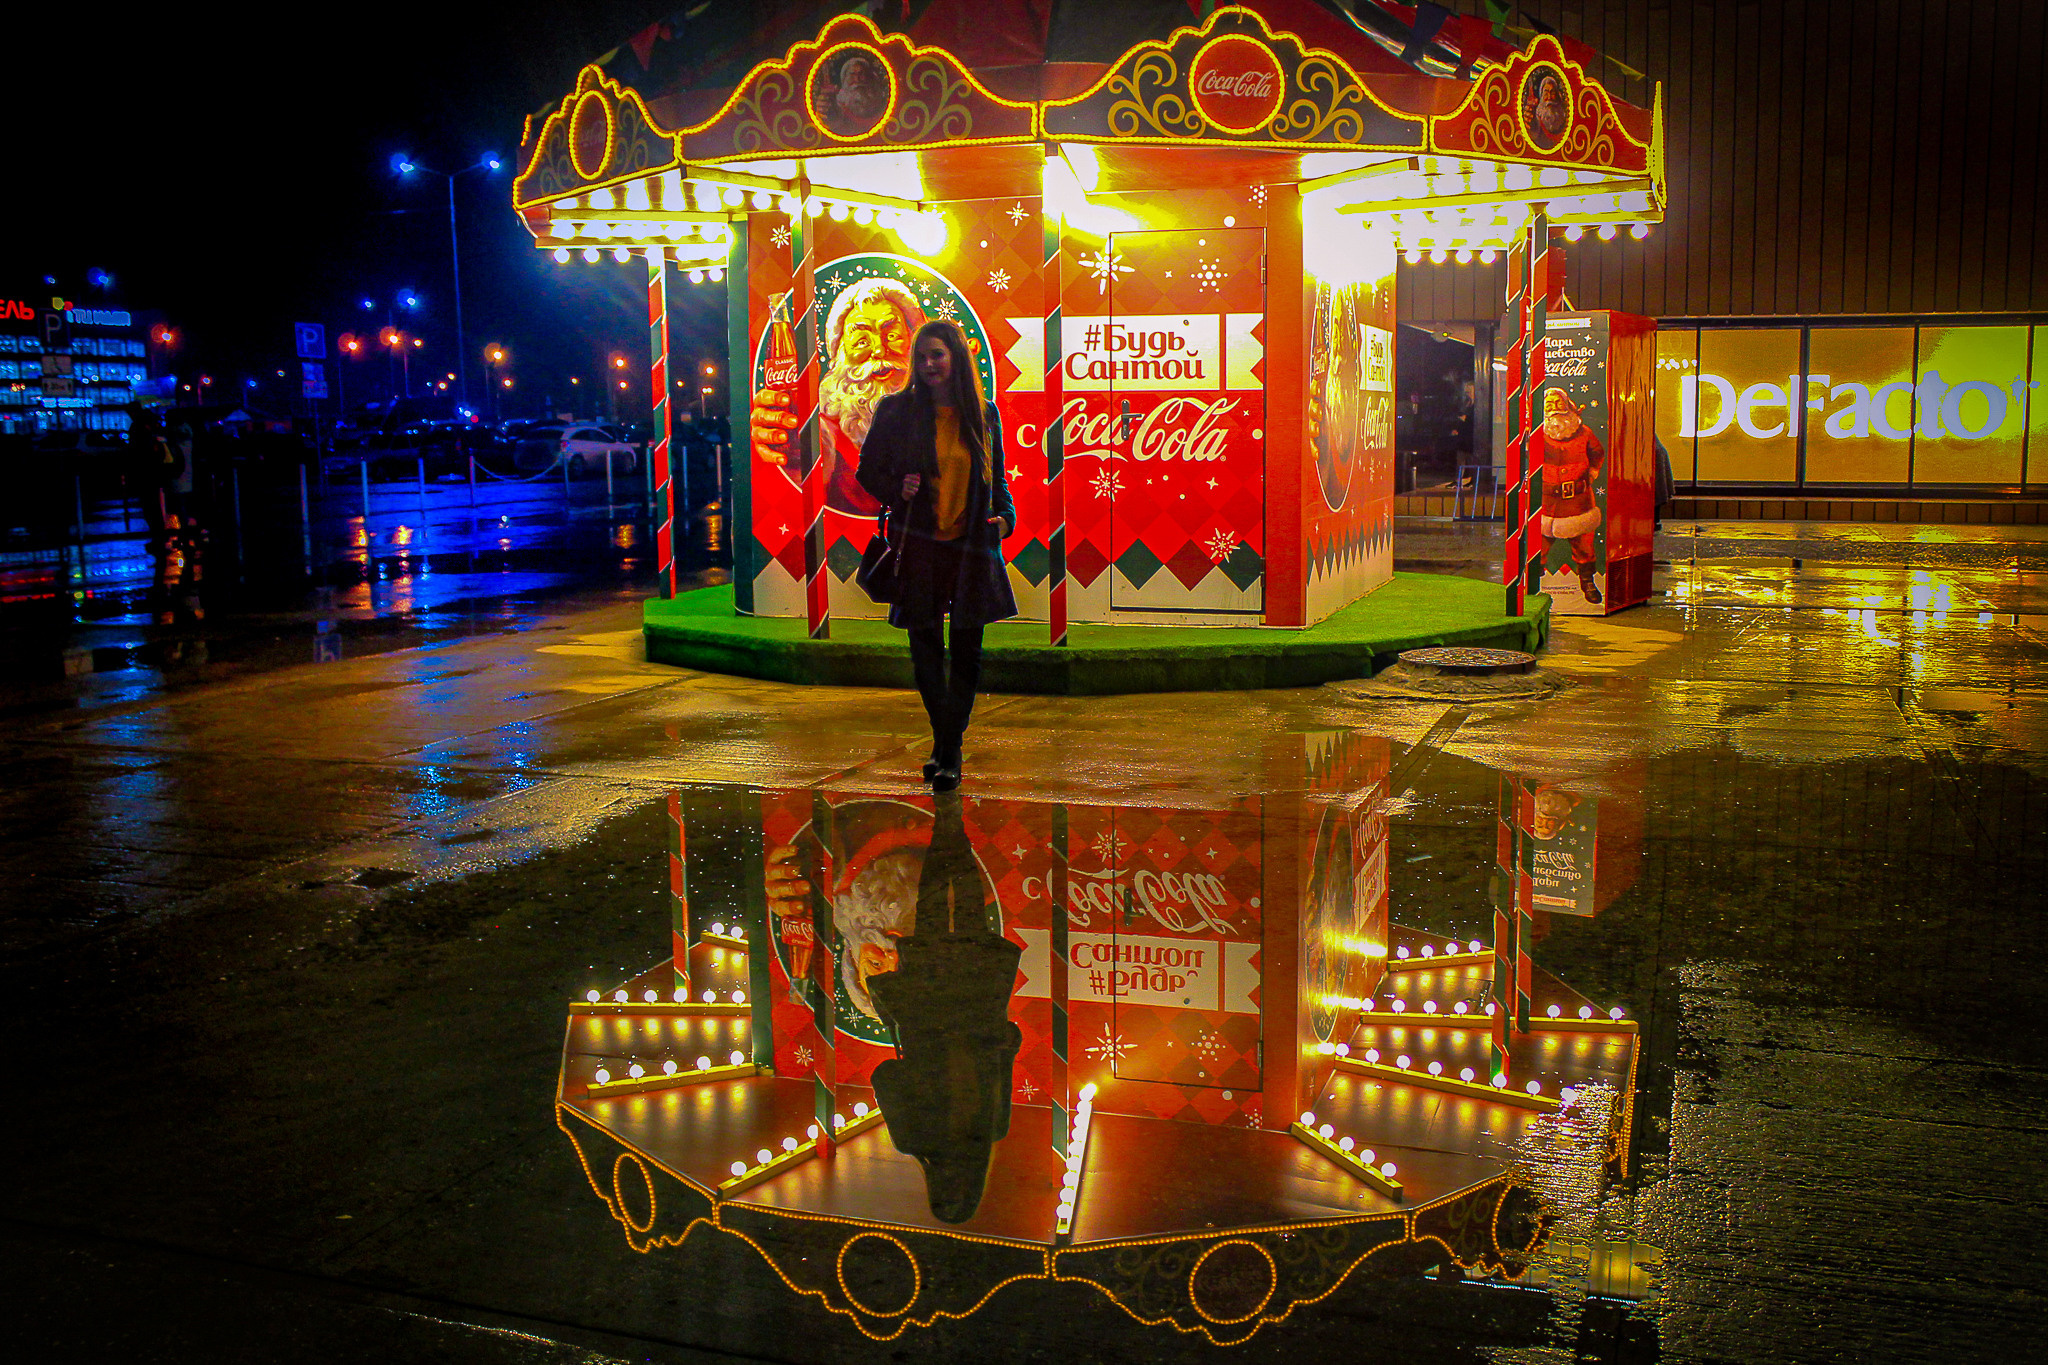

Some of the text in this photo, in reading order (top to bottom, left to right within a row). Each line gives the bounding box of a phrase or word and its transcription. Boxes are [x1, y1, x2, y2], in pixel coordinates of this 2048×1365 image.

[1198, 69, 1276, 98] Coca-Cola
[303, 327, 319, 353] P
[1084, 324, 1186, 358] #Будь
[1065, 350, 1206, 381] Сантой
[1042, 397, 1241, 462] Coca-Cola
